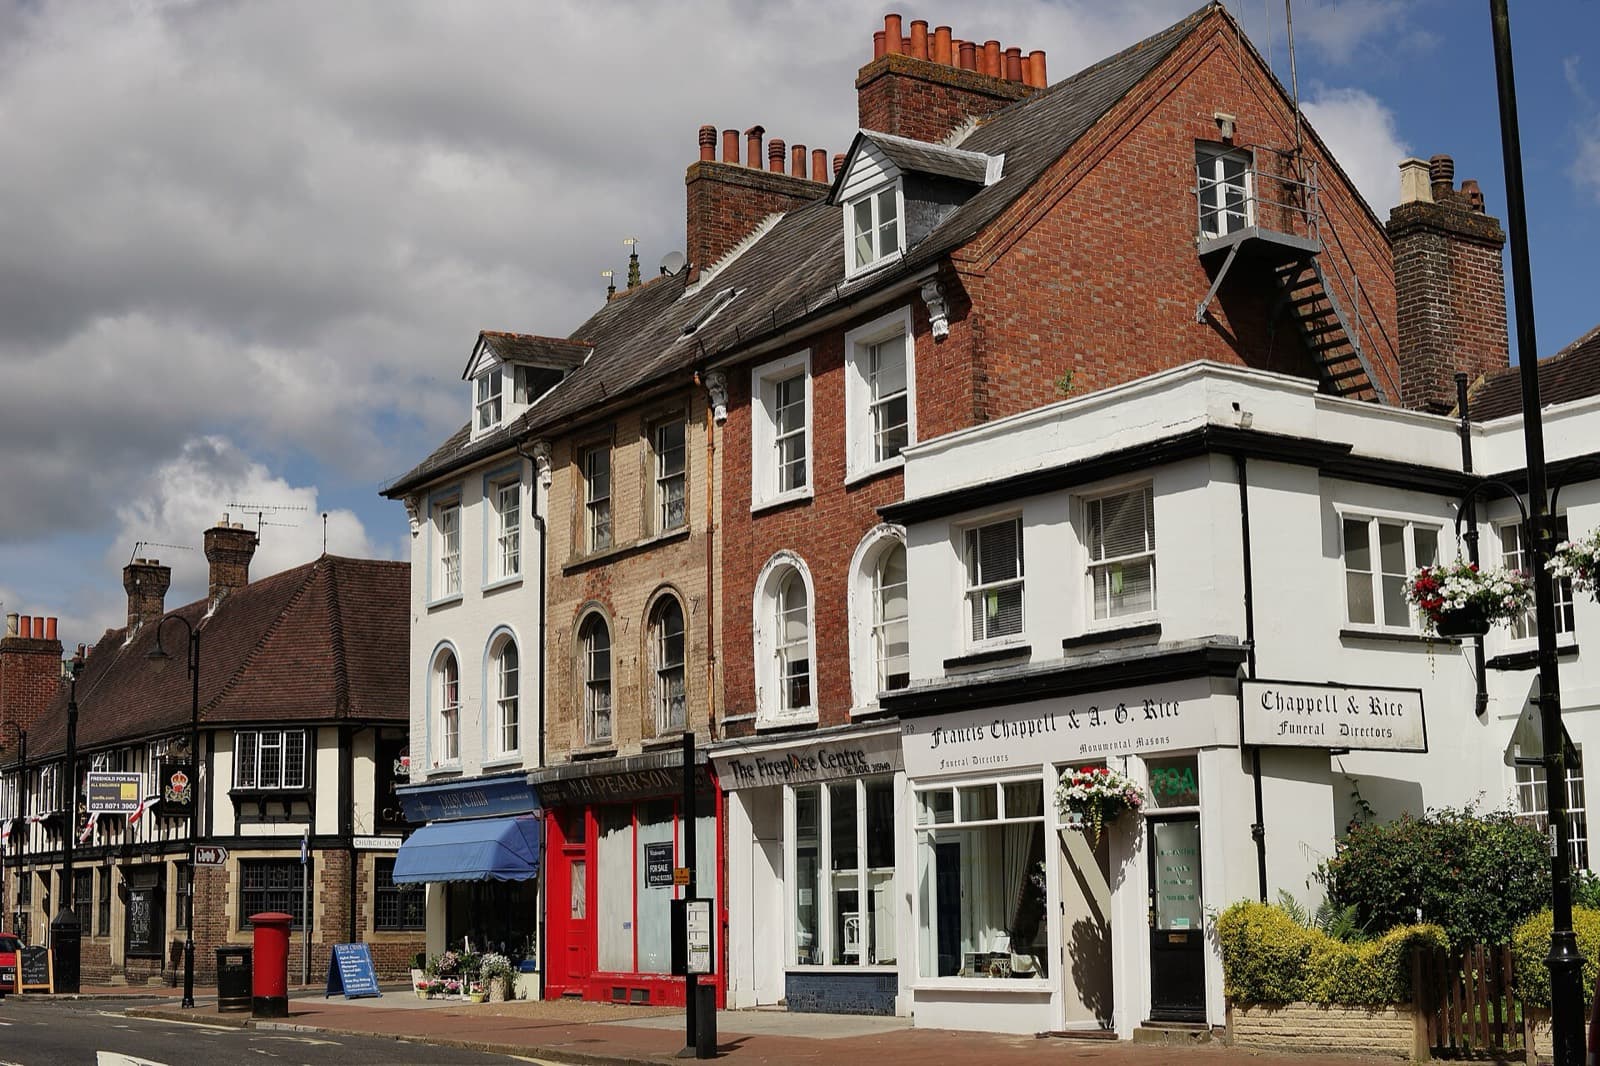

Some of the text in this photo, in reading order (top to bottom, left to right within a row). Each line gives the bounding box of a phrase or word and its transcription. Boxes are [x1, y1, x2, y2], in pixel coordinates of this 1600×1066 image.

[1260, 690, 1403, 717] Chappell & Rice
[930, 725, 984, 749] Francis
[990, 712, 1057, 740] Chappell
[1068, 708, 1080, 729] &
[1087, 705, 1107, 727] A.
[1142, 698, 1181, 721] Rice
[1277, 720, 1393, 738] Funeral Directors
[1079, 736, 1170, 755] Monumental Masons
[728, 759, 755, 780] The
[818, 749, 867, 769] Centre
[939, 753, 1009, 770] Funeral Directors
[1151, 767, 1198, 796] 79A
[462, 790, 489, 808] CHAIN
[650, 863, 668, 872] FOR SALE
